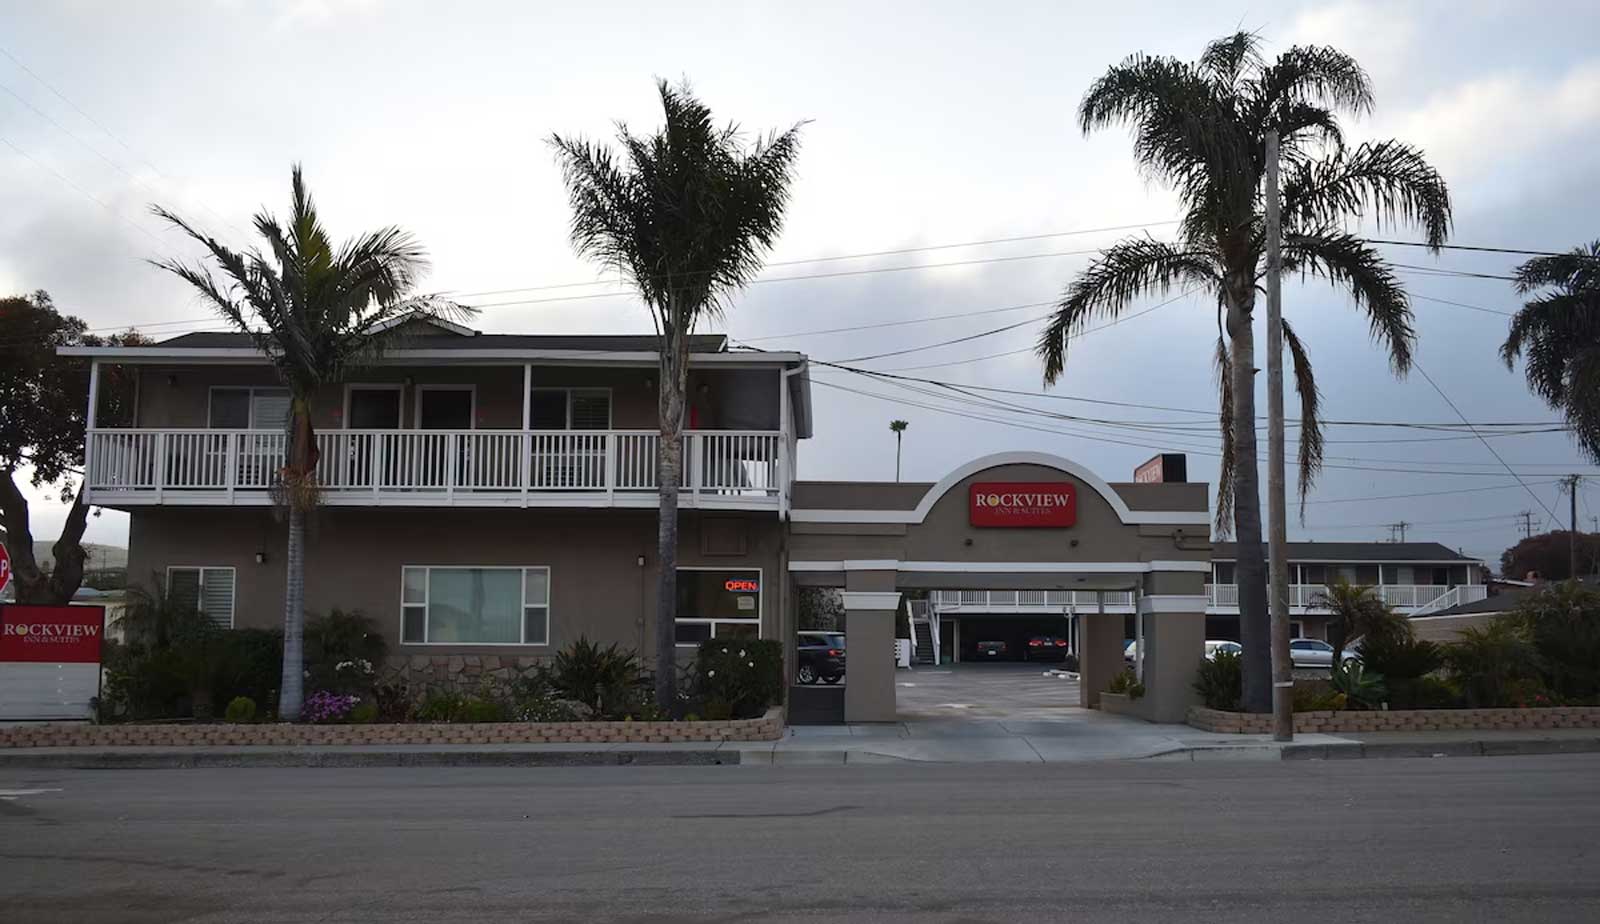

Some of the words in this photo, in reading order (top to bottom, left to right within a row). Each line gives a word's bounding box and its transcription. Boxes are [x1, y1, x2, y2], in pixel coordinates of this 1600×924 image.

[975, 493, 1070, 507] ROCKVIEW
[725, 580, 757, 591] OPEN
[3, 623, 99, 636] ROCKVIEW
